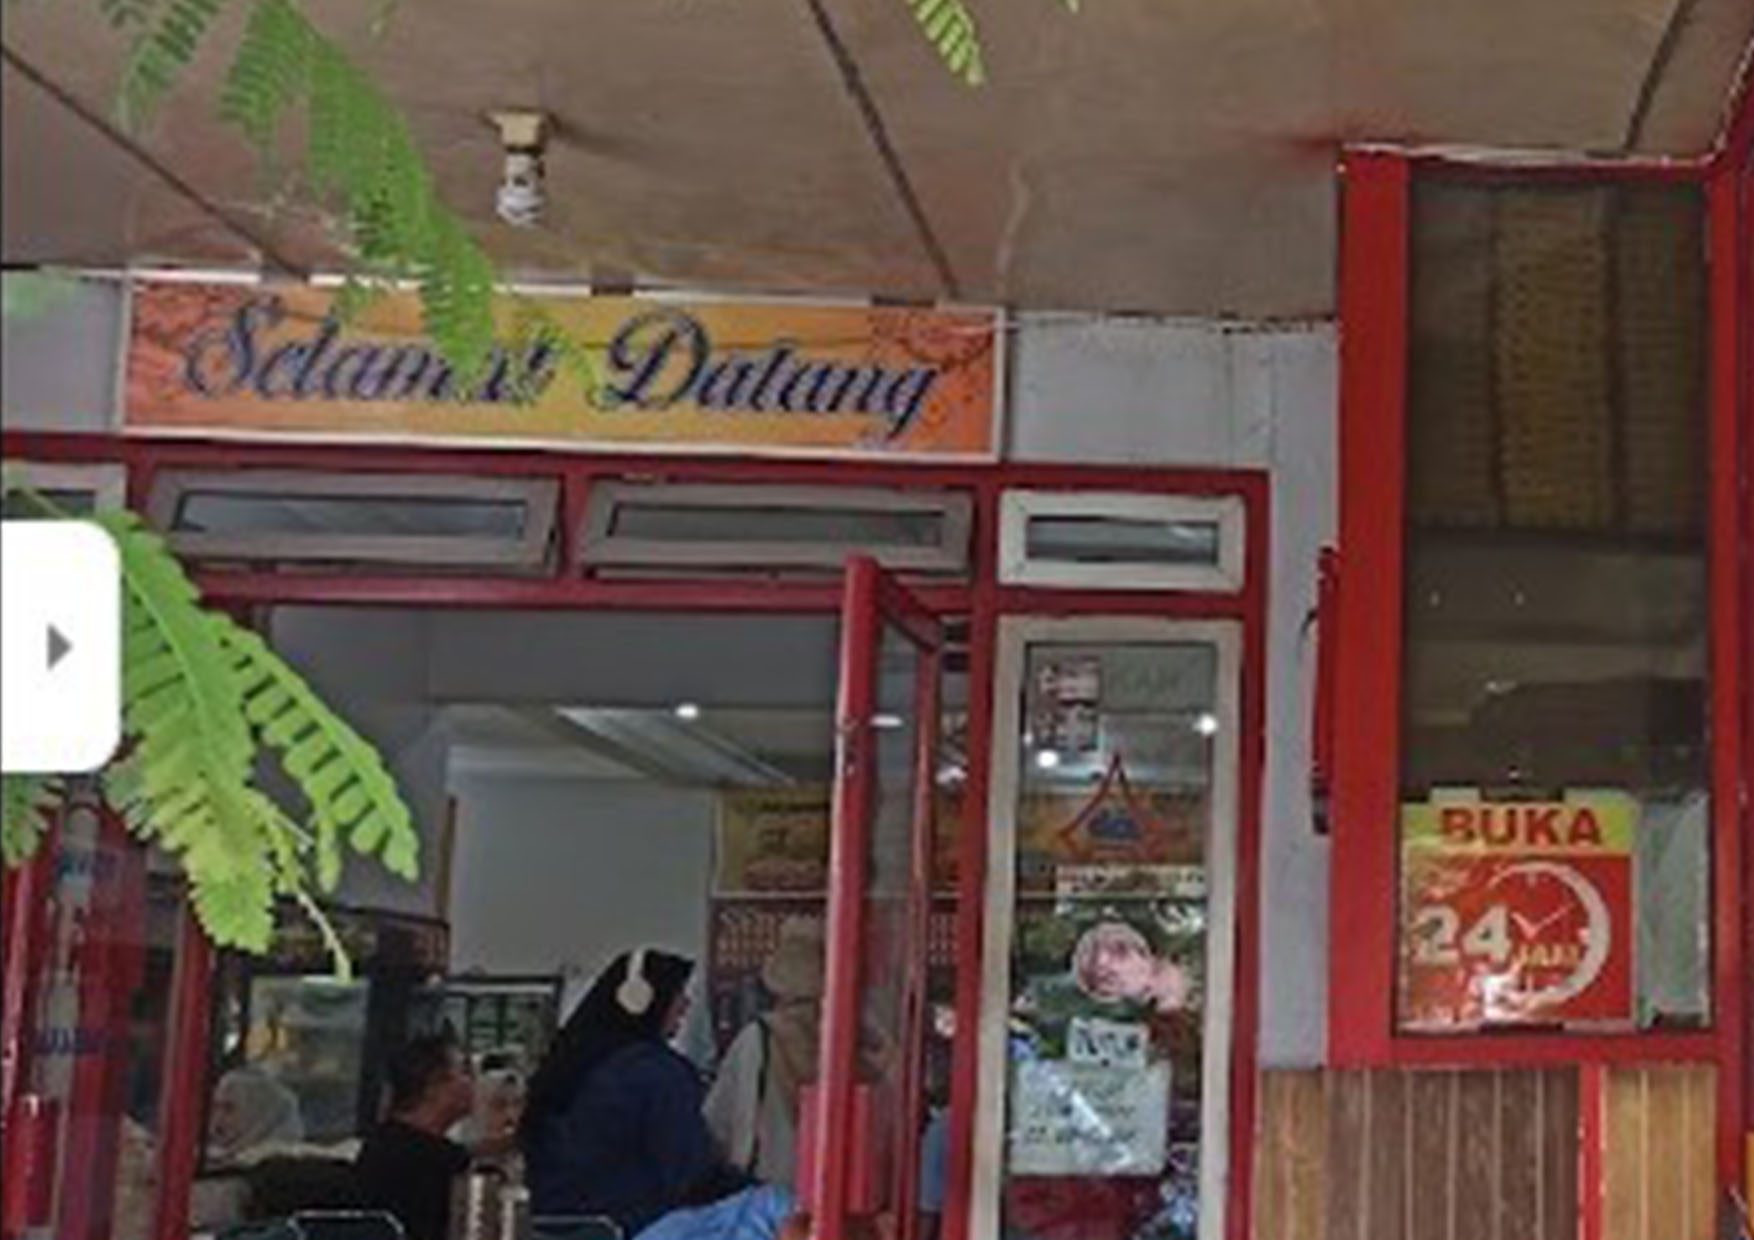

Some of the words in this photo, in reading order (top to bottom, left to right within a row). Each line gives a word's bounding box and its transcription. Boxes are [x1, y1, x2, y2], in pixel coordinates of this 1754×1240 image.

[586, 307, 940, 448] Datang
[1438, 808, 1603, 846] BUKA
[1412, 904, 1513, 966] 24
